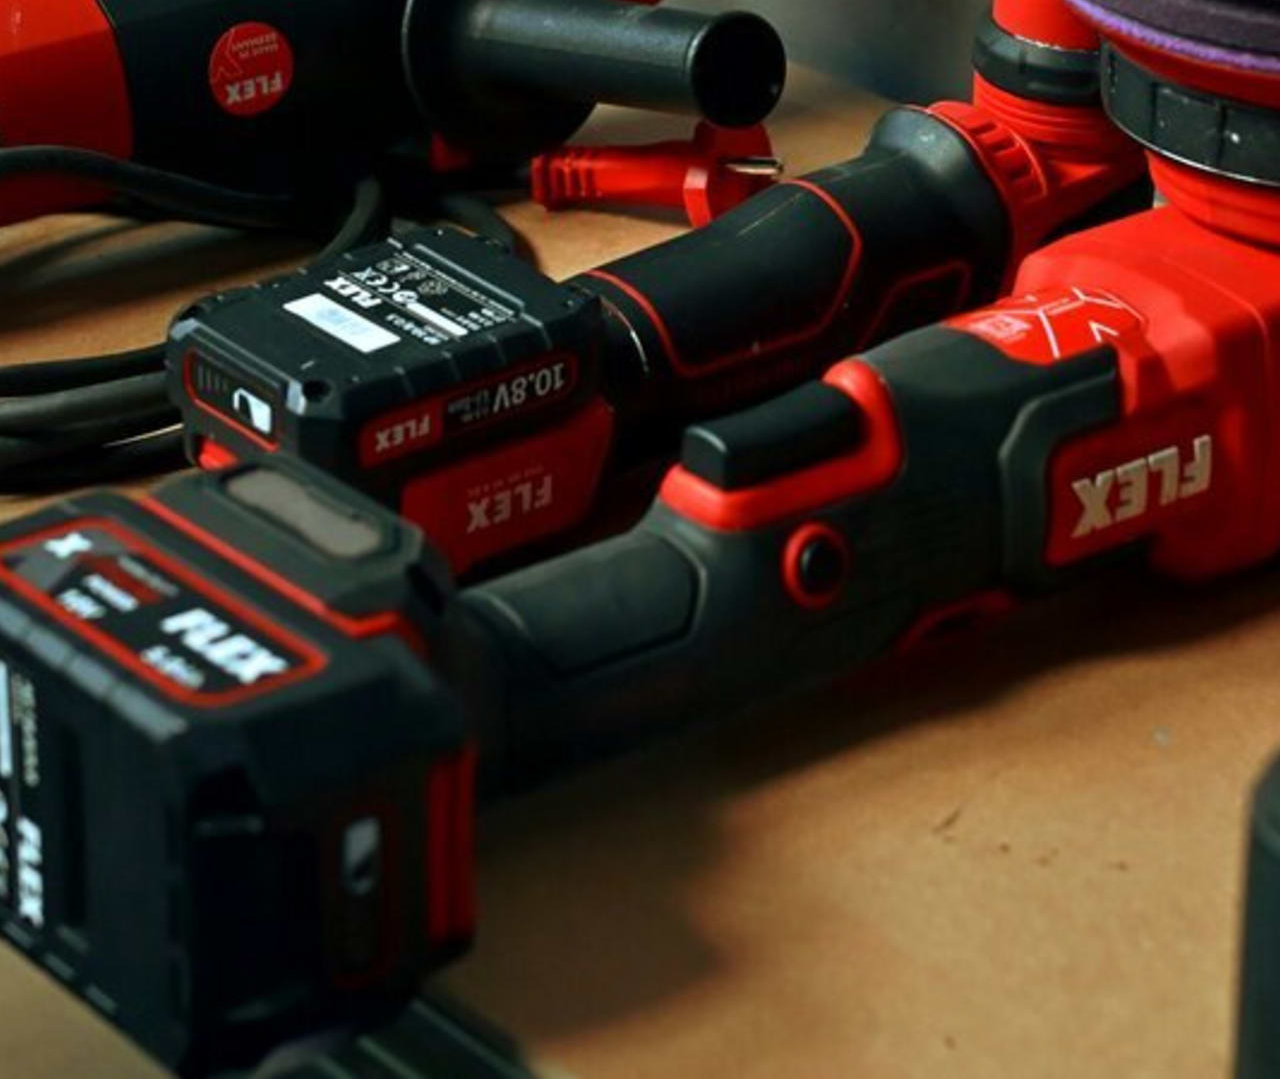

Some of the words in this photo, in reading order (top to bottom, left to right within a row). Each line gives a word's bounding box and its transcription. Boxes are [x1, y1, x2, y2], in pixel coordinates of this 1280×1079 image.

[224, 72, 284, 105] FLEX
[322, 275, 382, 309] FLEX
[492, 362, 566, 413] 10.8V
[375, 414, 430, 453] FLEX
[467, 474, 554, 534] FLEX
[1070, 434, 1212, 538] FLEX
[160, 606, 291, 685] FLEX
[17, 815, 44, 928] FLEX
